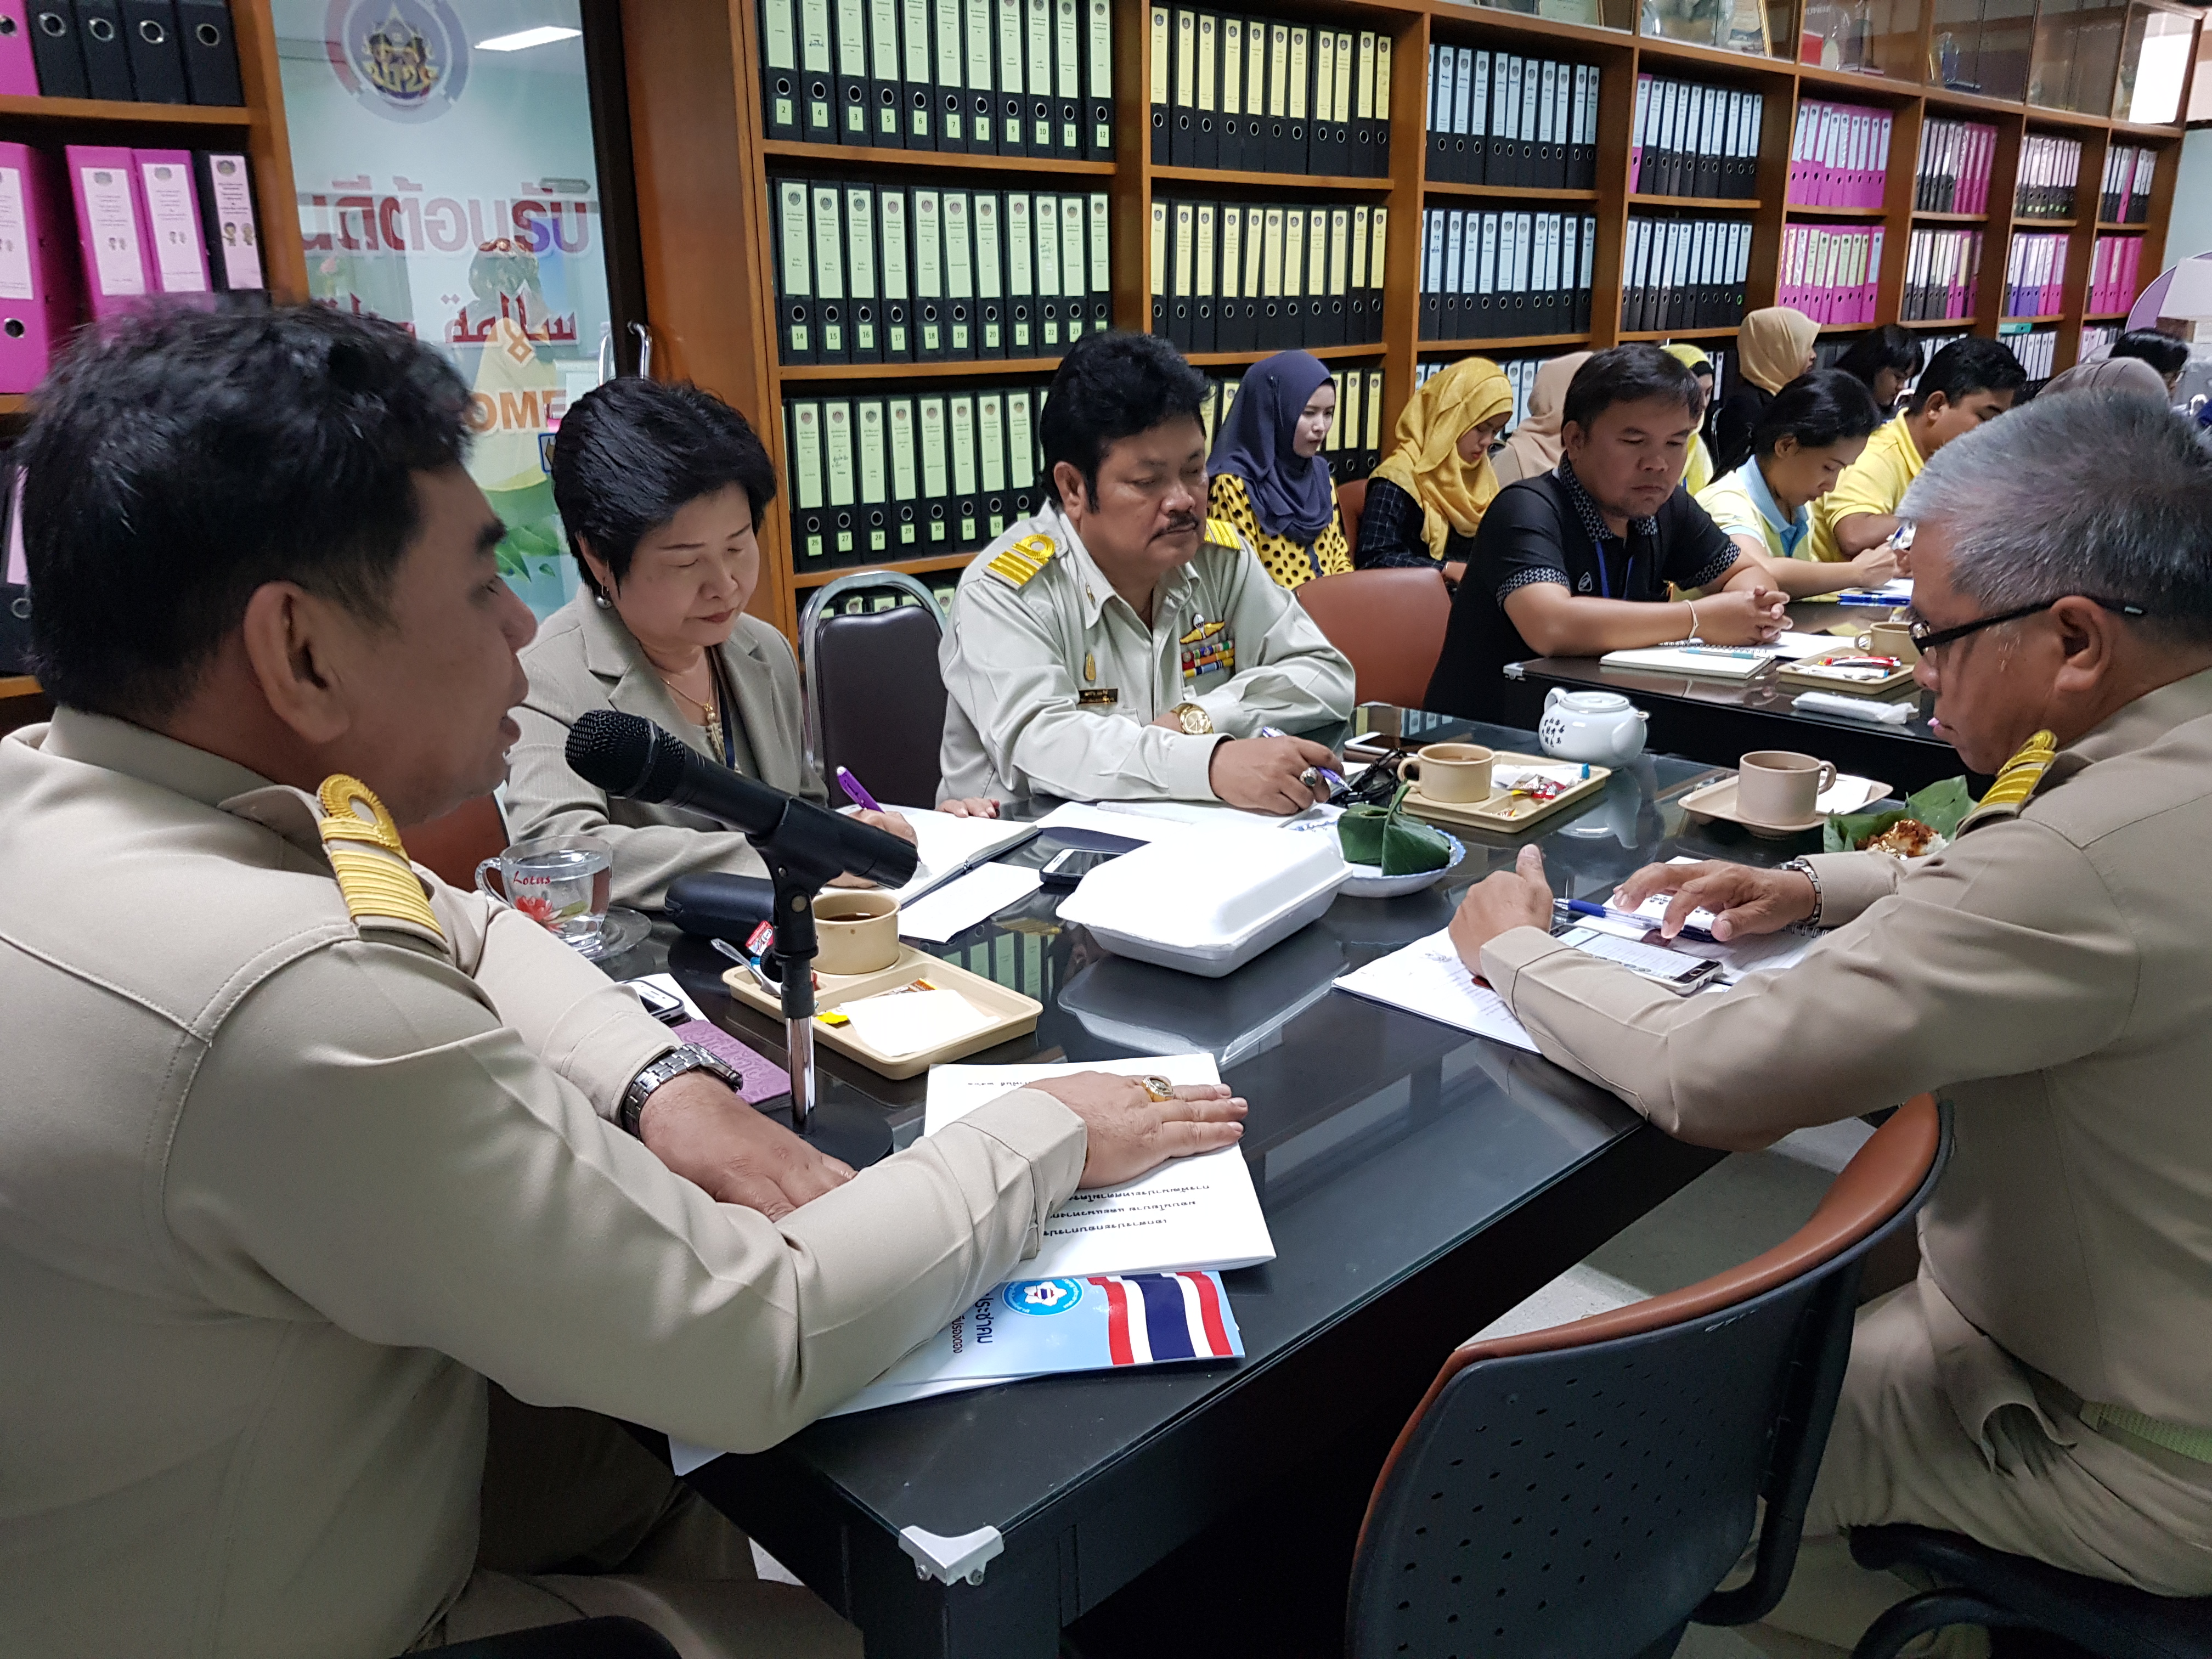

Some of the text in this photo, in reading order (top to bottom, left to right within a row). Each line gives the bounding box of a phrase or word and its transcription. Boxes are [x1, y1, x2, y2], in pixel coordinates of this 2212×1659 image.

[514, 871, 551, 885] Lotus
[1050, 1200, 1196, 1219] มอบนโยบาย และแนวทางก
